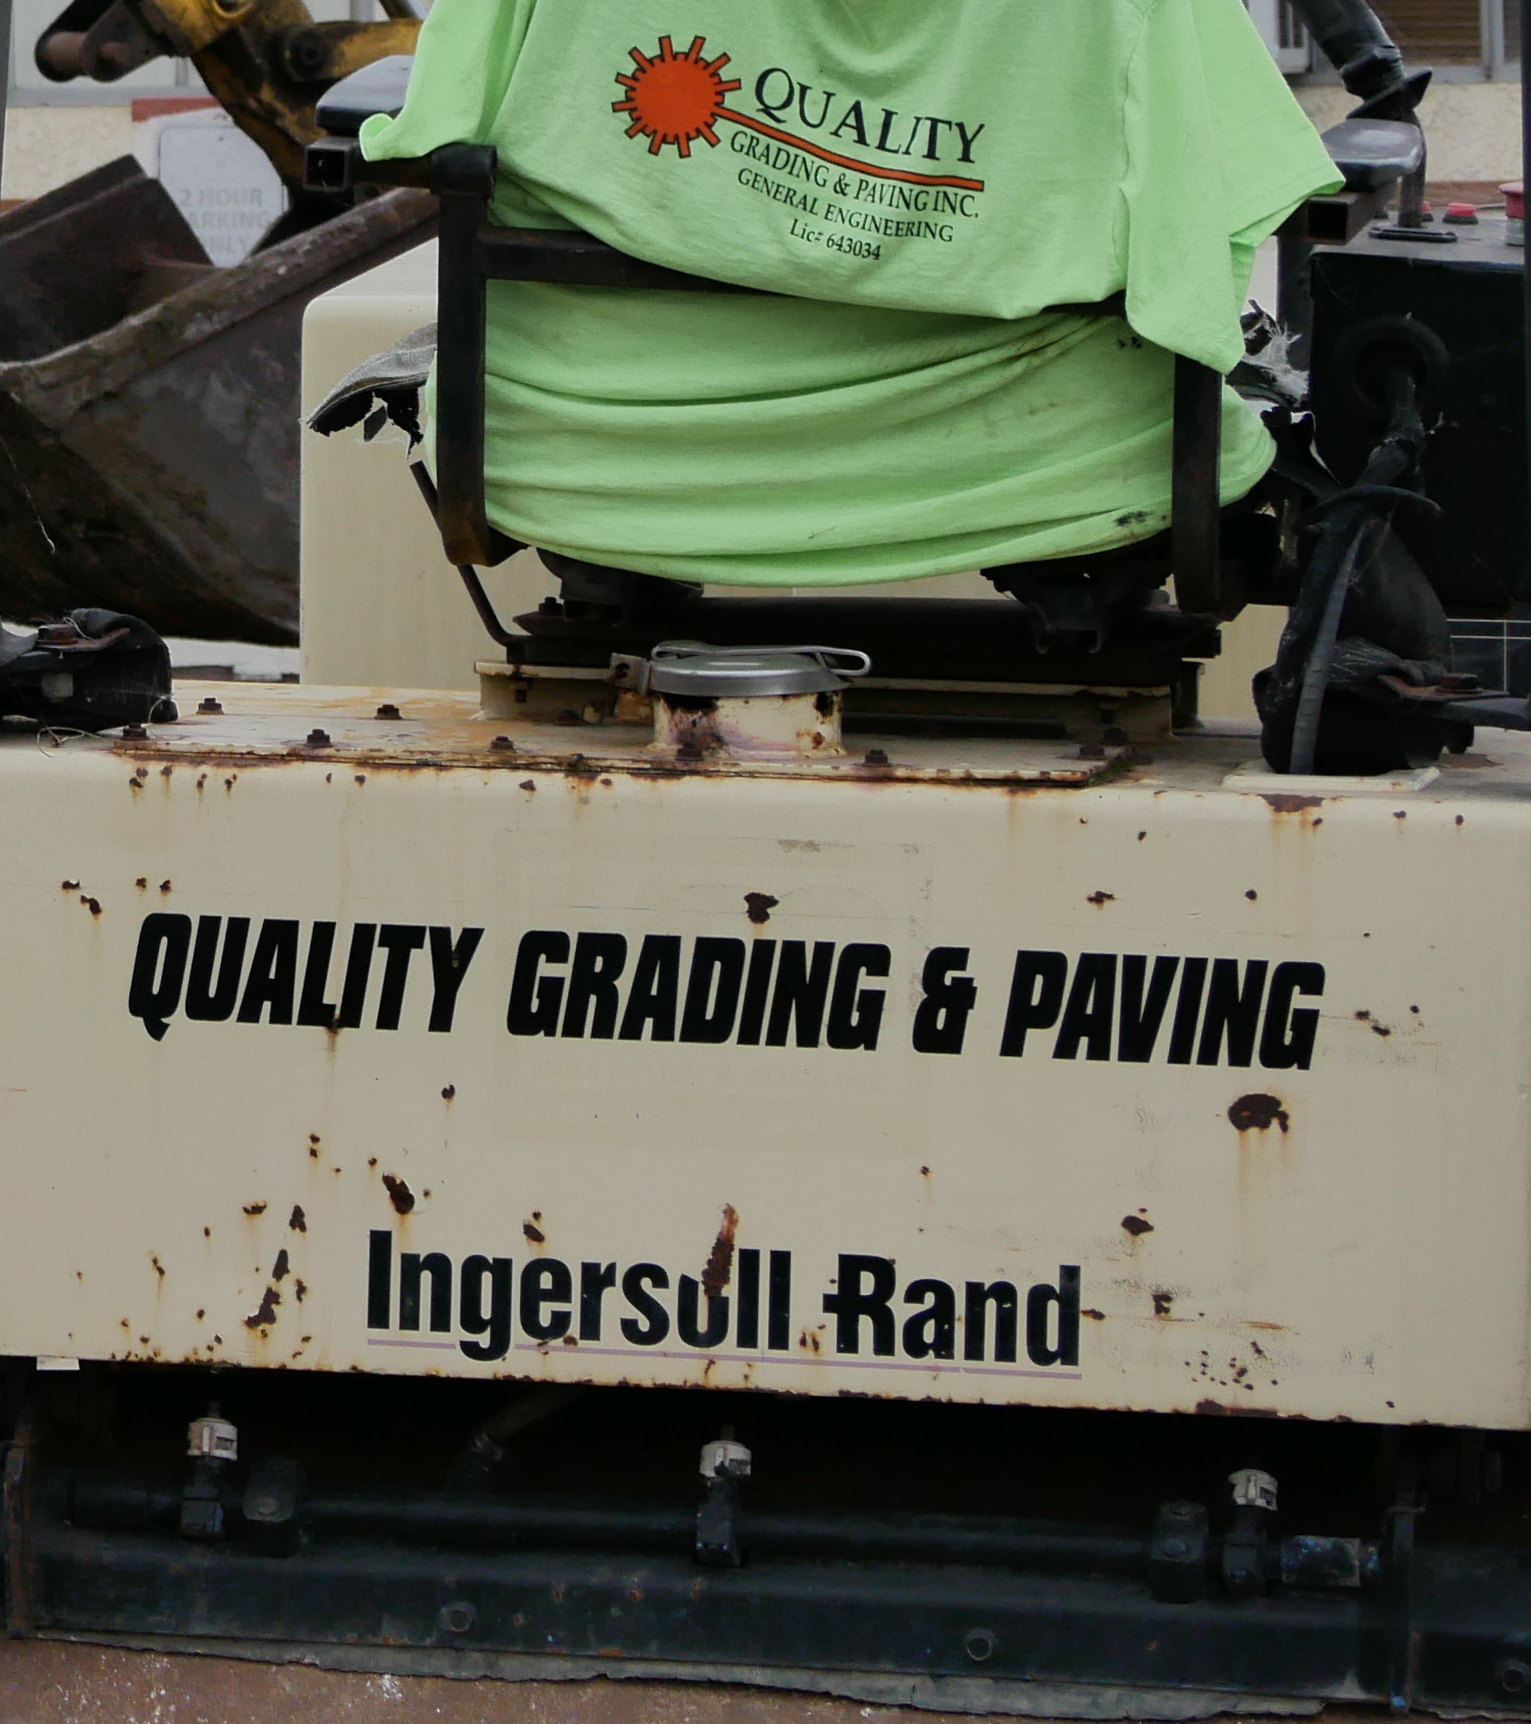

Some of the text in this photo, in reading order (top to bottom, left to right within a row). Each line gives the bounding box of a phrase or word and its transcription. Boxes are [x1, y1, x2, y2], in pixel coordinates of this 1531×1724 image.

[754, 67, 985, 164] QUALITY
[179, 187, 263, 208] 2 HOUR
[729, 129, 979, 218] GRADING & PAVING INC.
[737, 167, 954, 243] GENERAL ENGINEERING
[186, 210, 270, 231] ARKING
[200, 233, 252, 255] NLY
[825, 233, 882, 261] 643034
[128, 912, 1327, 1071] QUALITY GRADING & PAVING
[367, 1229, 791, 1363] Ingersoll
